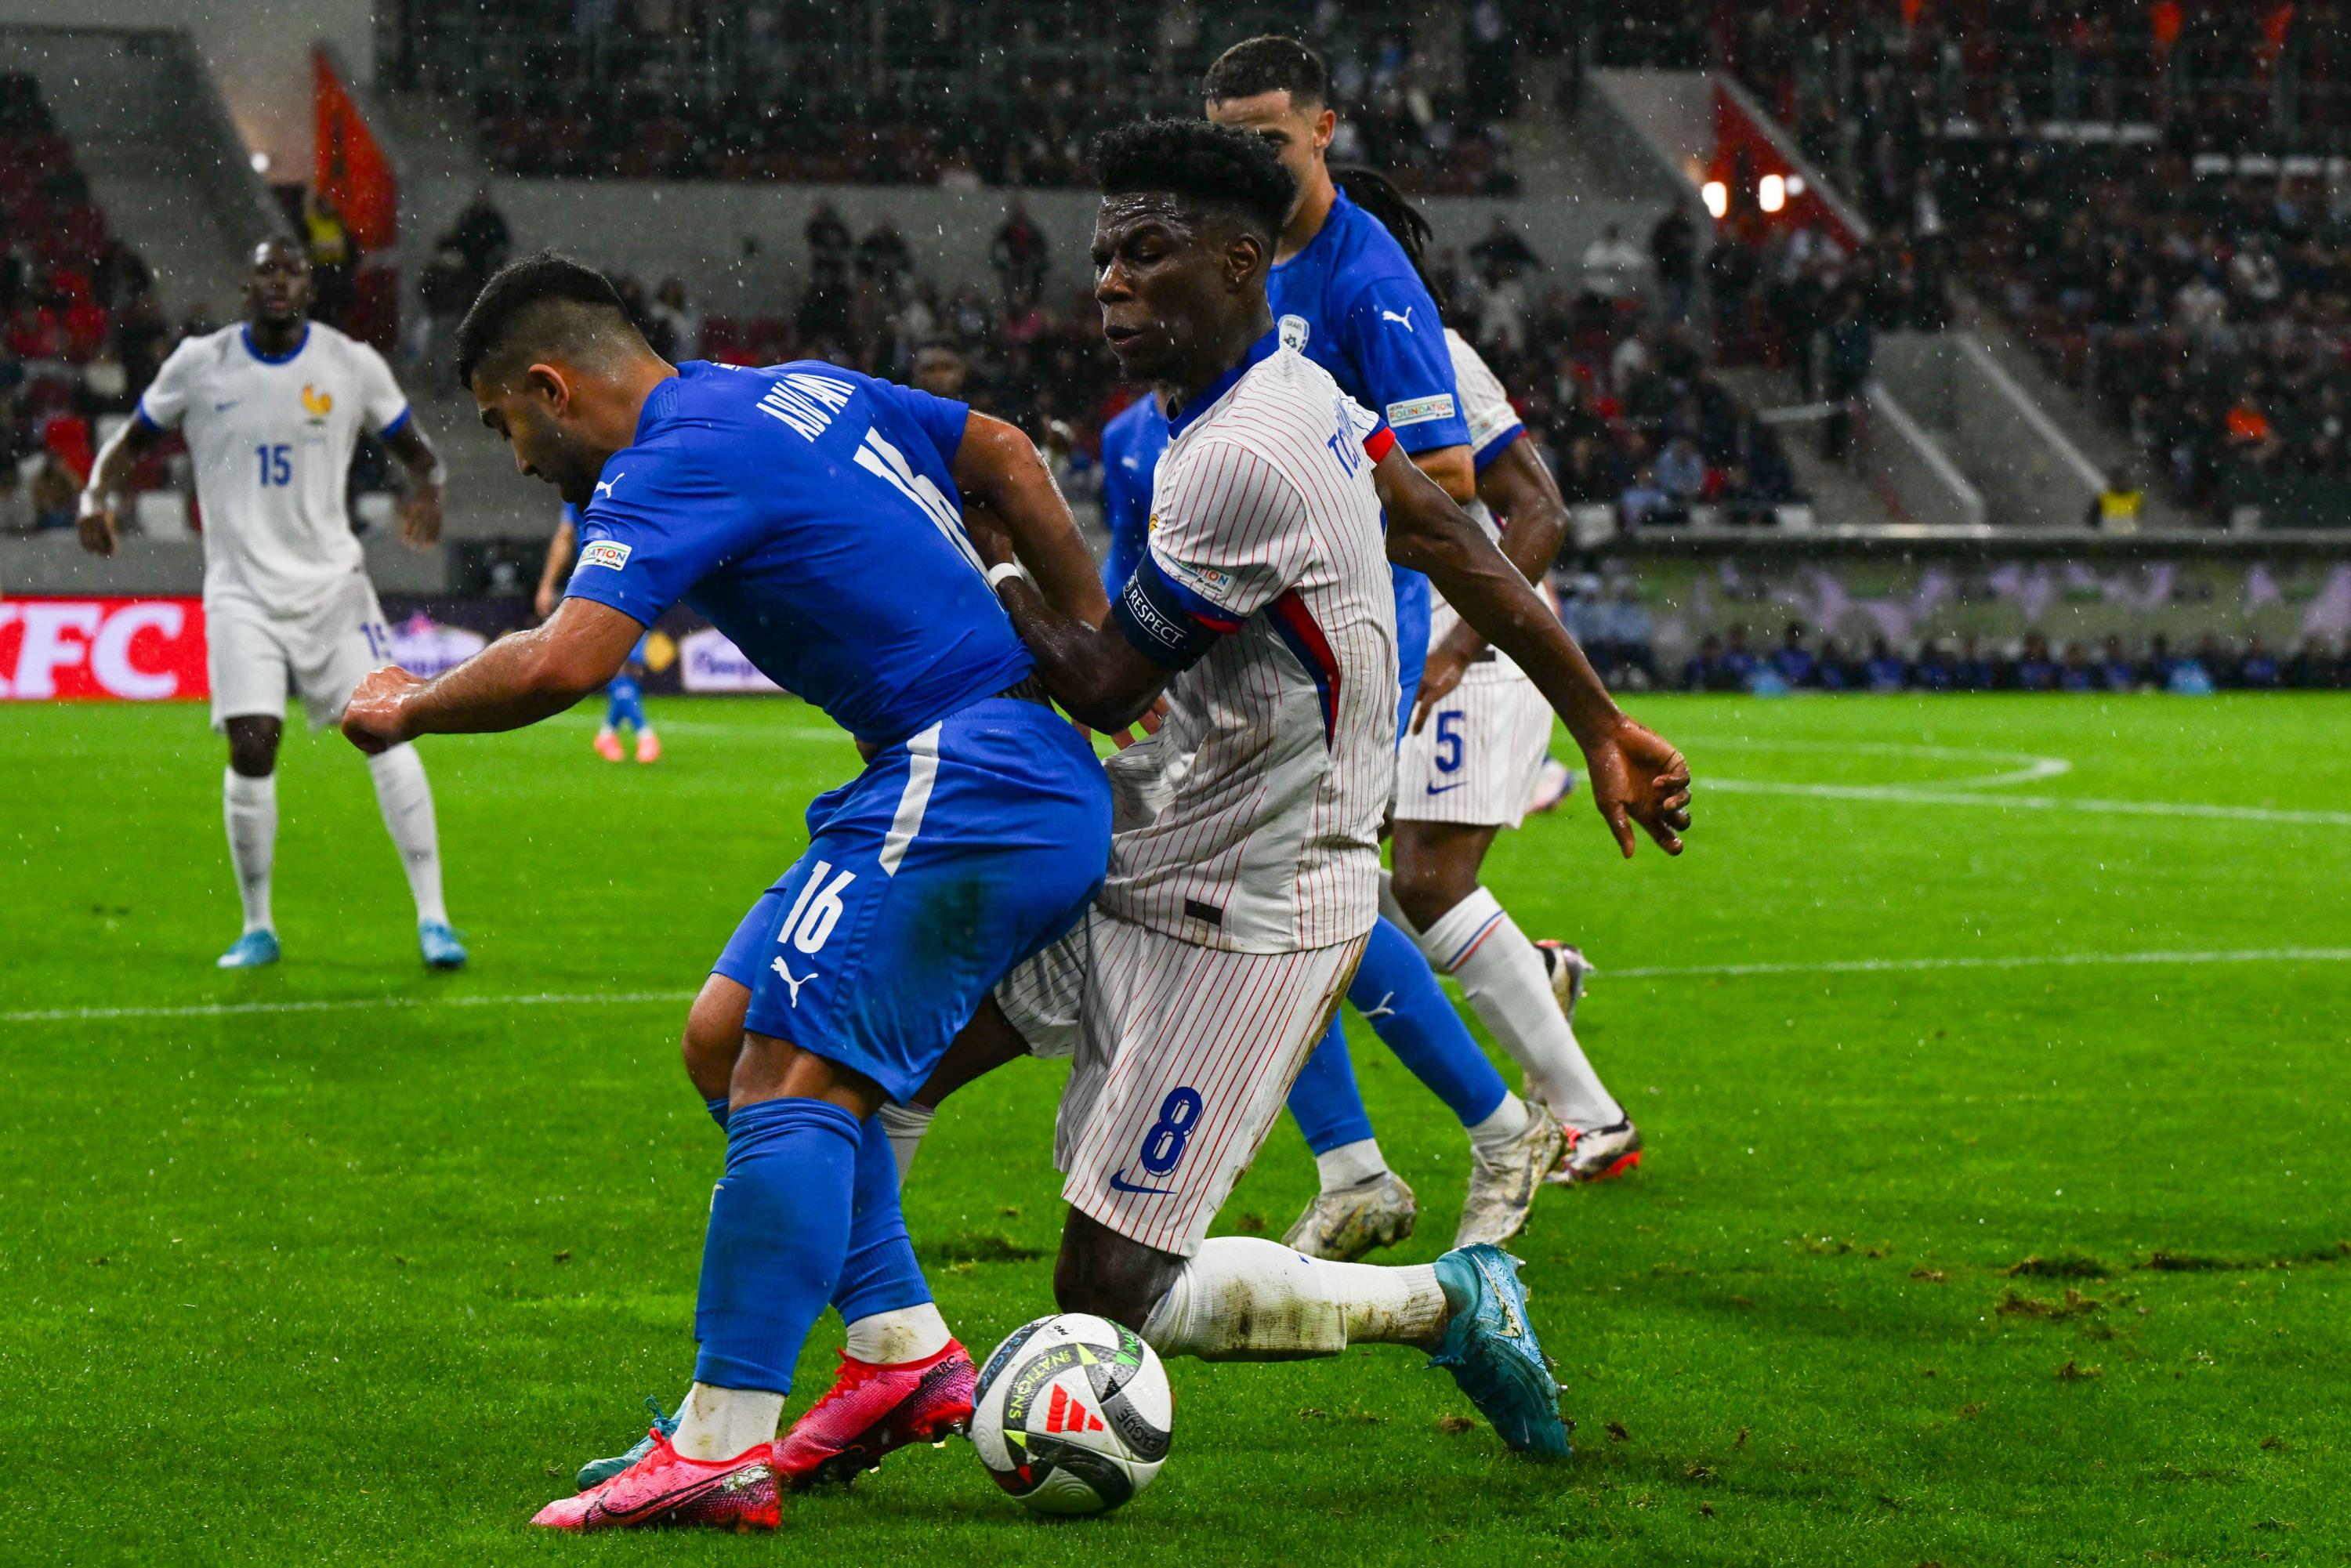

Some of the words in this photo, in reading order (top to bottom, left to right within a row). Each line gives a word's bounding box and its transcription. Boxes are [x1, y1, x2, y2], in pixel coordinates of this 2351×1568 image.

[1389, 402, 1452, 419] FOUNDATION
[255, 444, 292, 487] 15
[1128, 588, 1183, 643] RESPECT
[1435, 710, 1464, 774] 5
[777, 860, 857, 954] 16
[1140, 1086, 1203, 1177] 8
[1009, 1350, 1067, 1419] NATIONS
